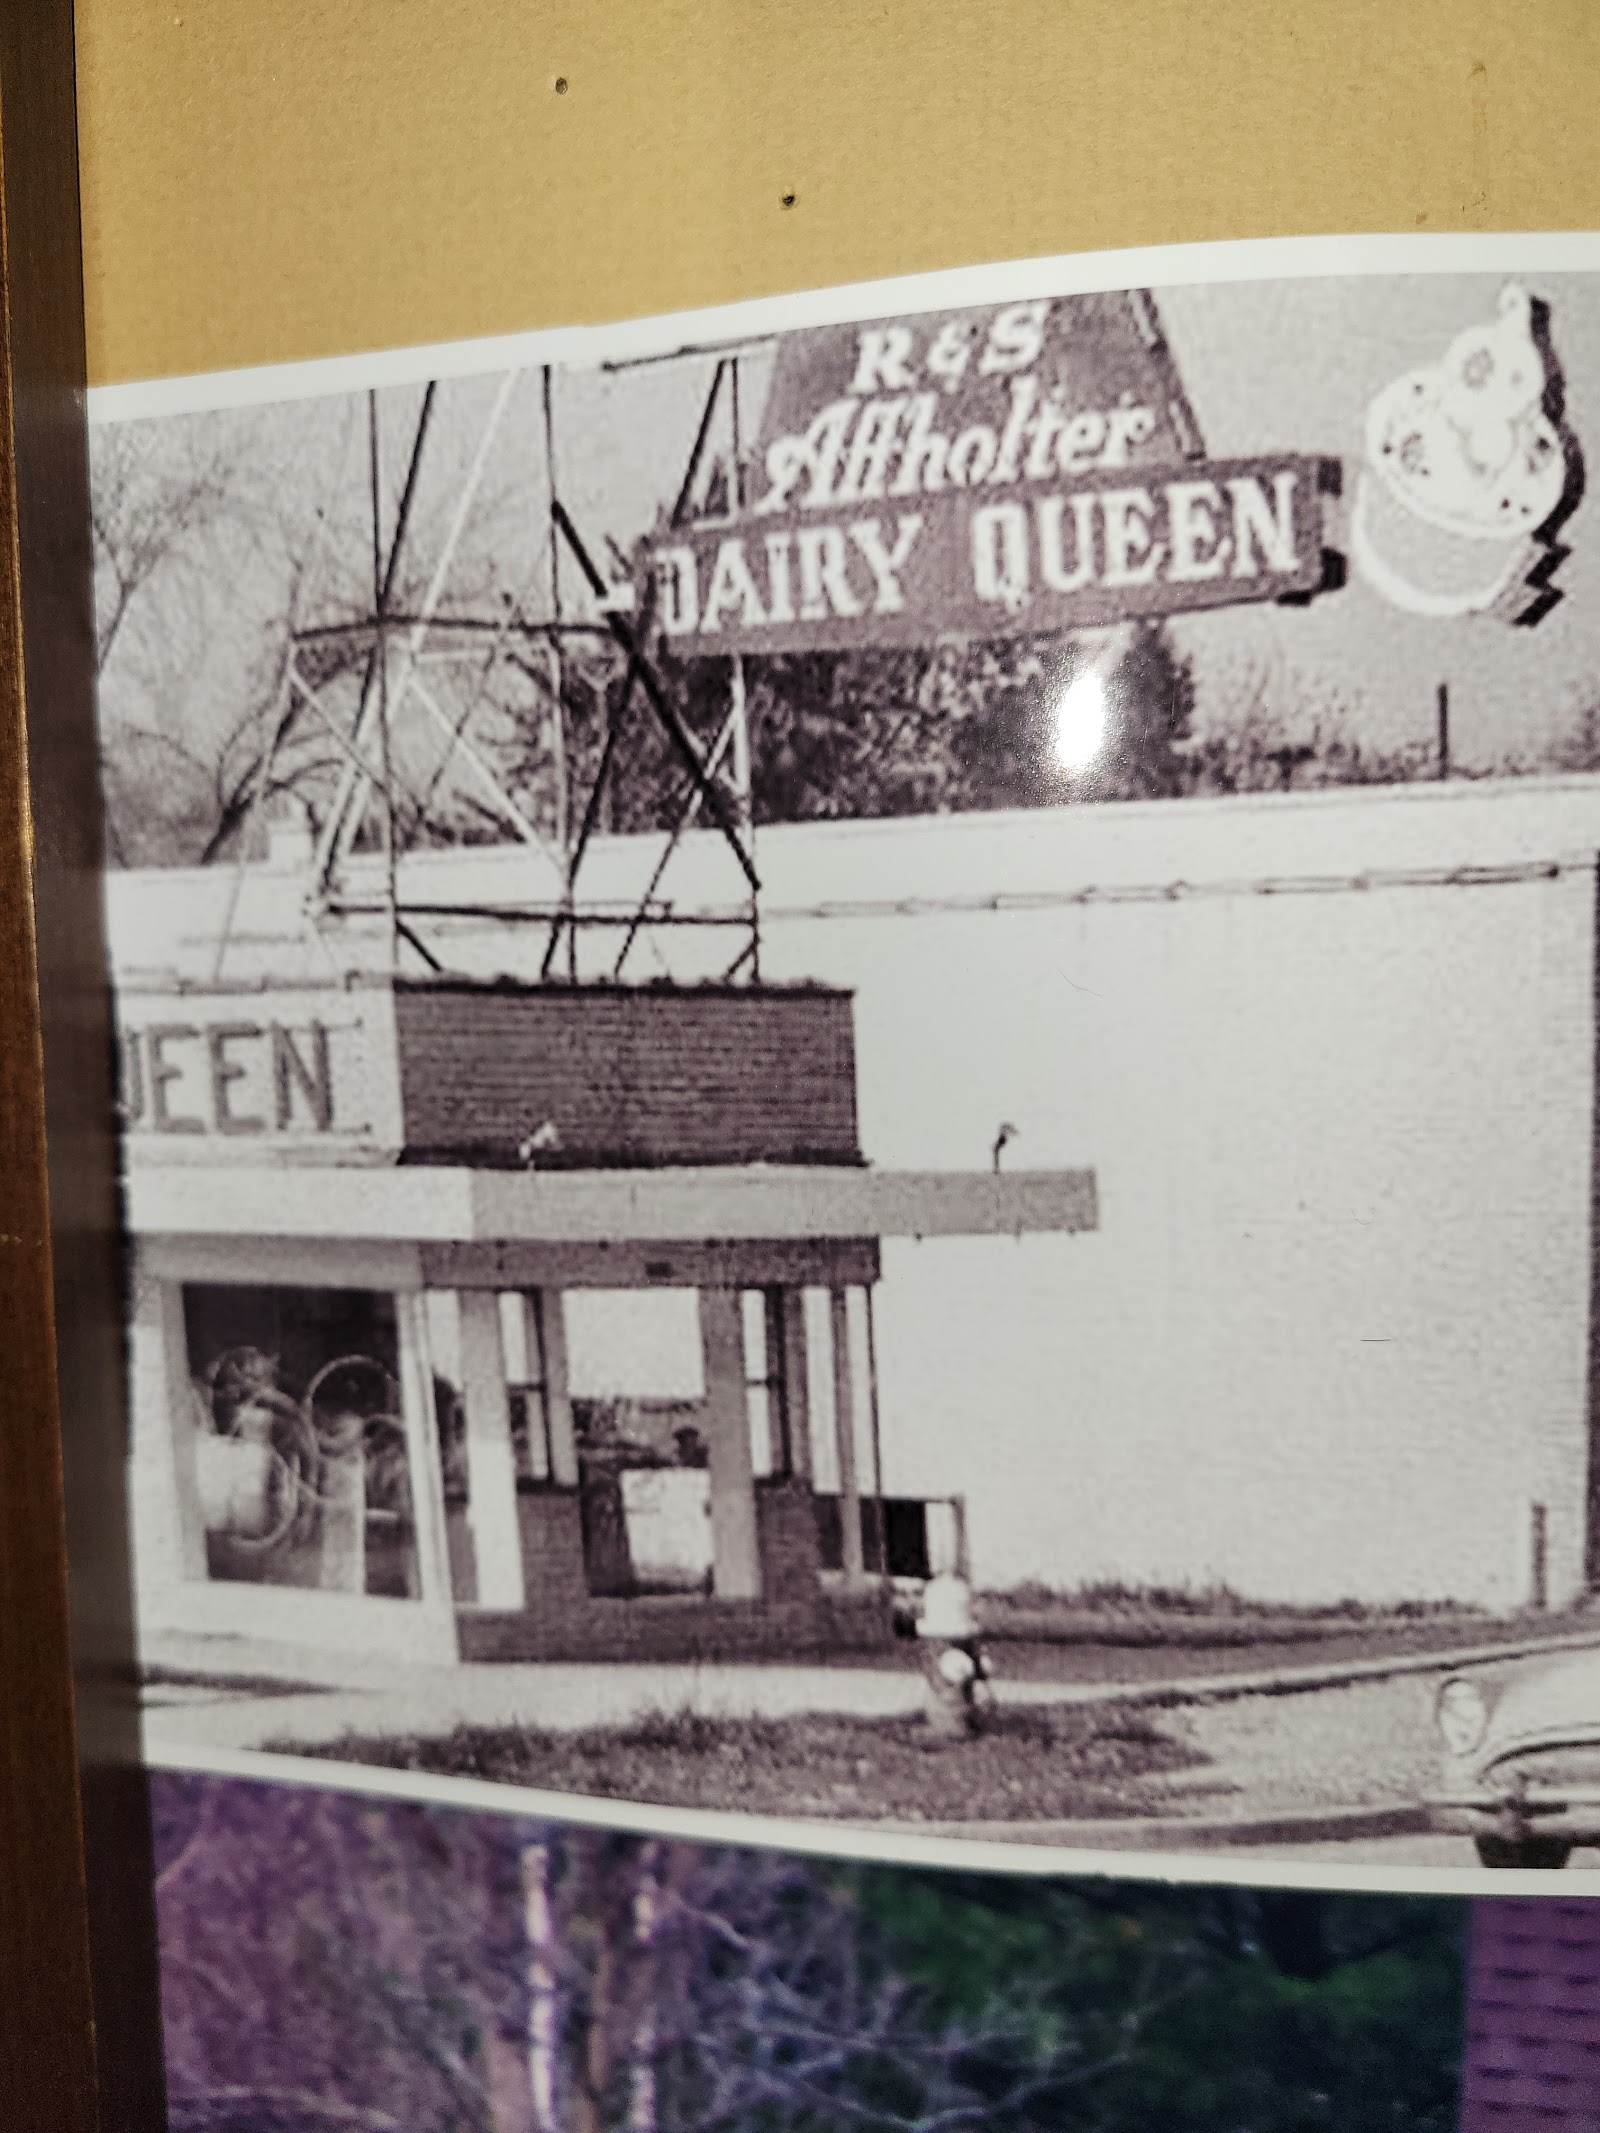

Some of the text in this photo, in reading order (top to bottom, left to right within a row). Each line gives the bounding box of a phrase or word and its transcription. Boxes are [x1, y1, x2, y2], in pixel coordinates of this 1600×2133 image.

[753, 376, 1156, 514] Affholter
[654, 471, 1302, 636] DAIRY QUEEN
